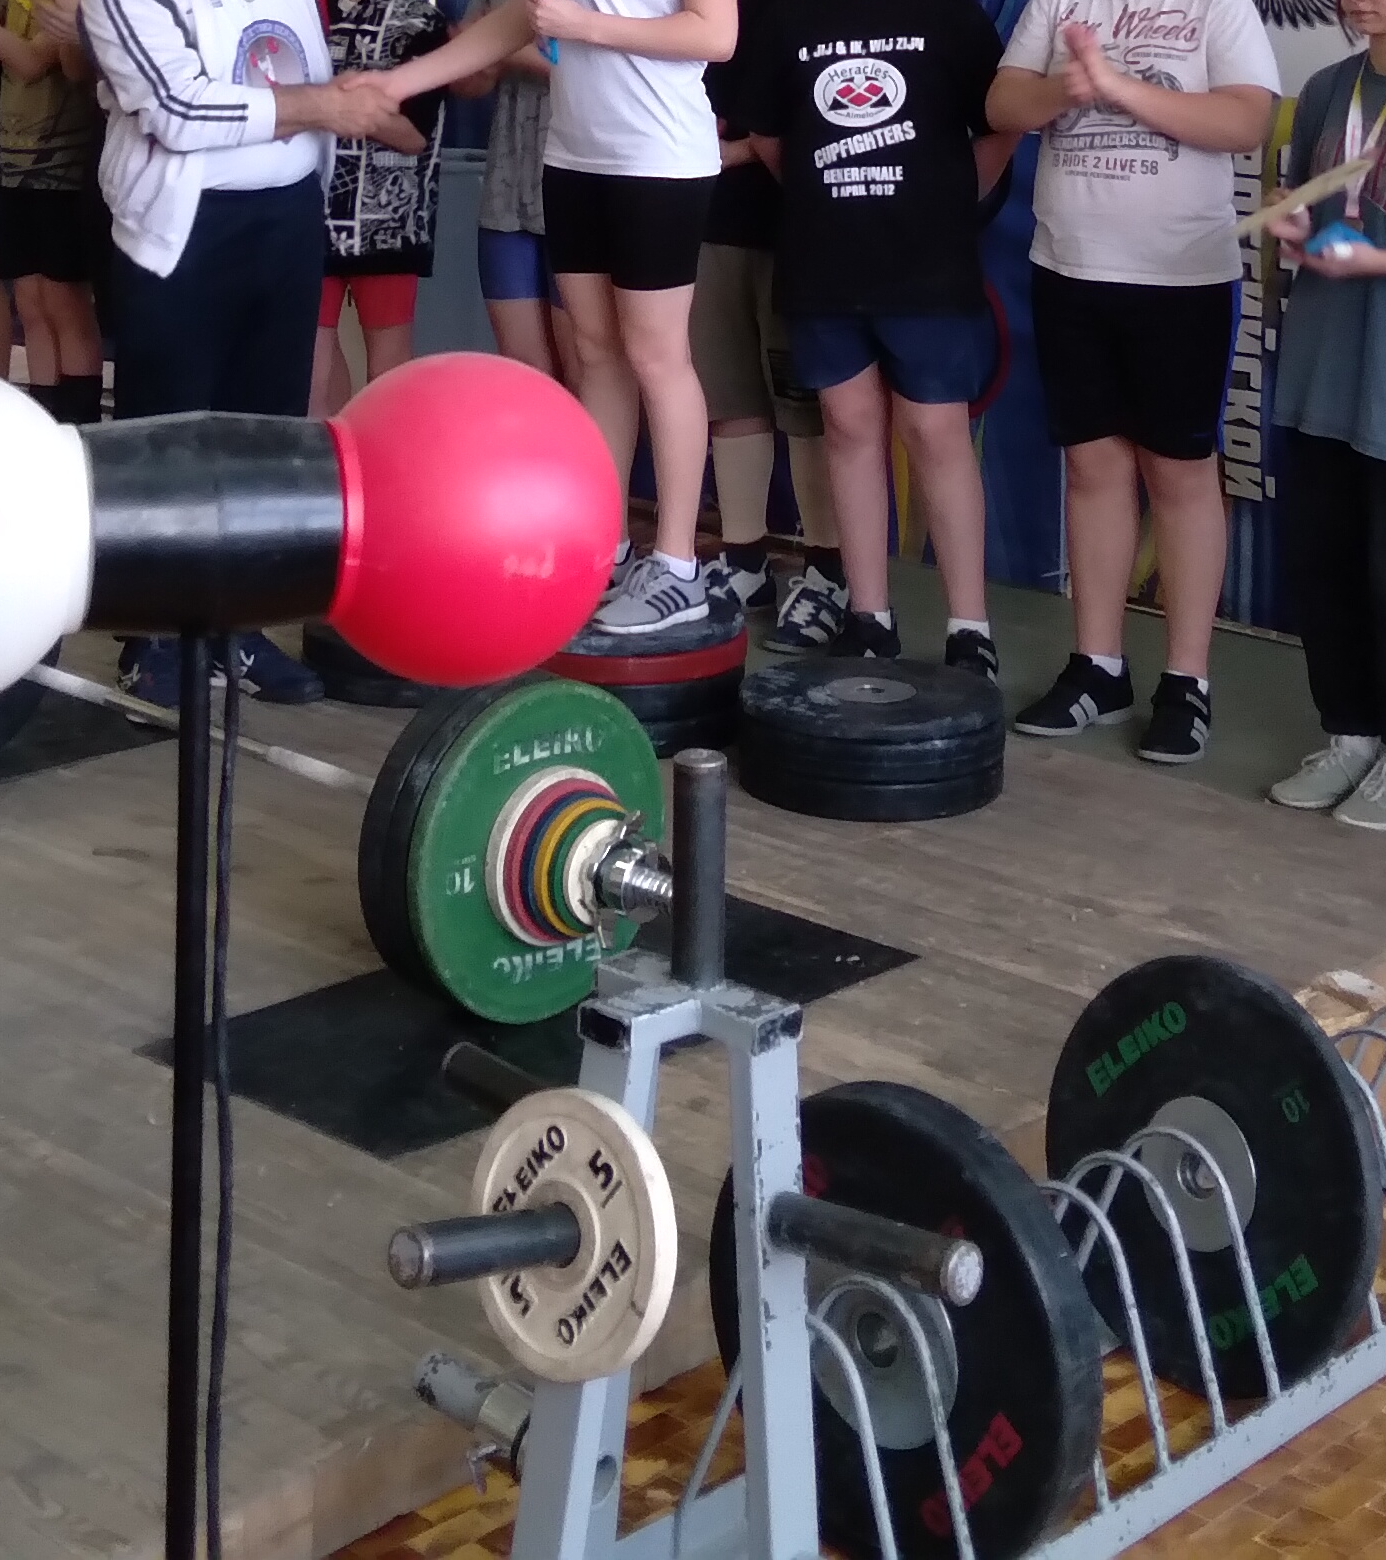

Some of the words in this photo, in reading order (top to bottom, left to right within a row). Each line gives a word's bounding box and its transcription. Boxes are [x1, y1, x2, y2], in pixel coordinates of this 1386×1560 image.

[1112, 2, 1205, 44] Wheels
[827, 63, 890, 83] Heracles
[813, 119, 917, 169] CUPFIGHTERS
[823, 165, 904, 184] BEKERFINALE
[1093, 156, 1102, 170] 2
[1105, 157, 1138, 174] LIVE
[1140, 160, 1159, 176] 58
[839, 184, 867, 198] APRIL
[869, 183, 896, 197] 2012
[1085, 1000, 1187, 1098] ELEIKO
[556, 1238, 633, 1348] ELEIKO
